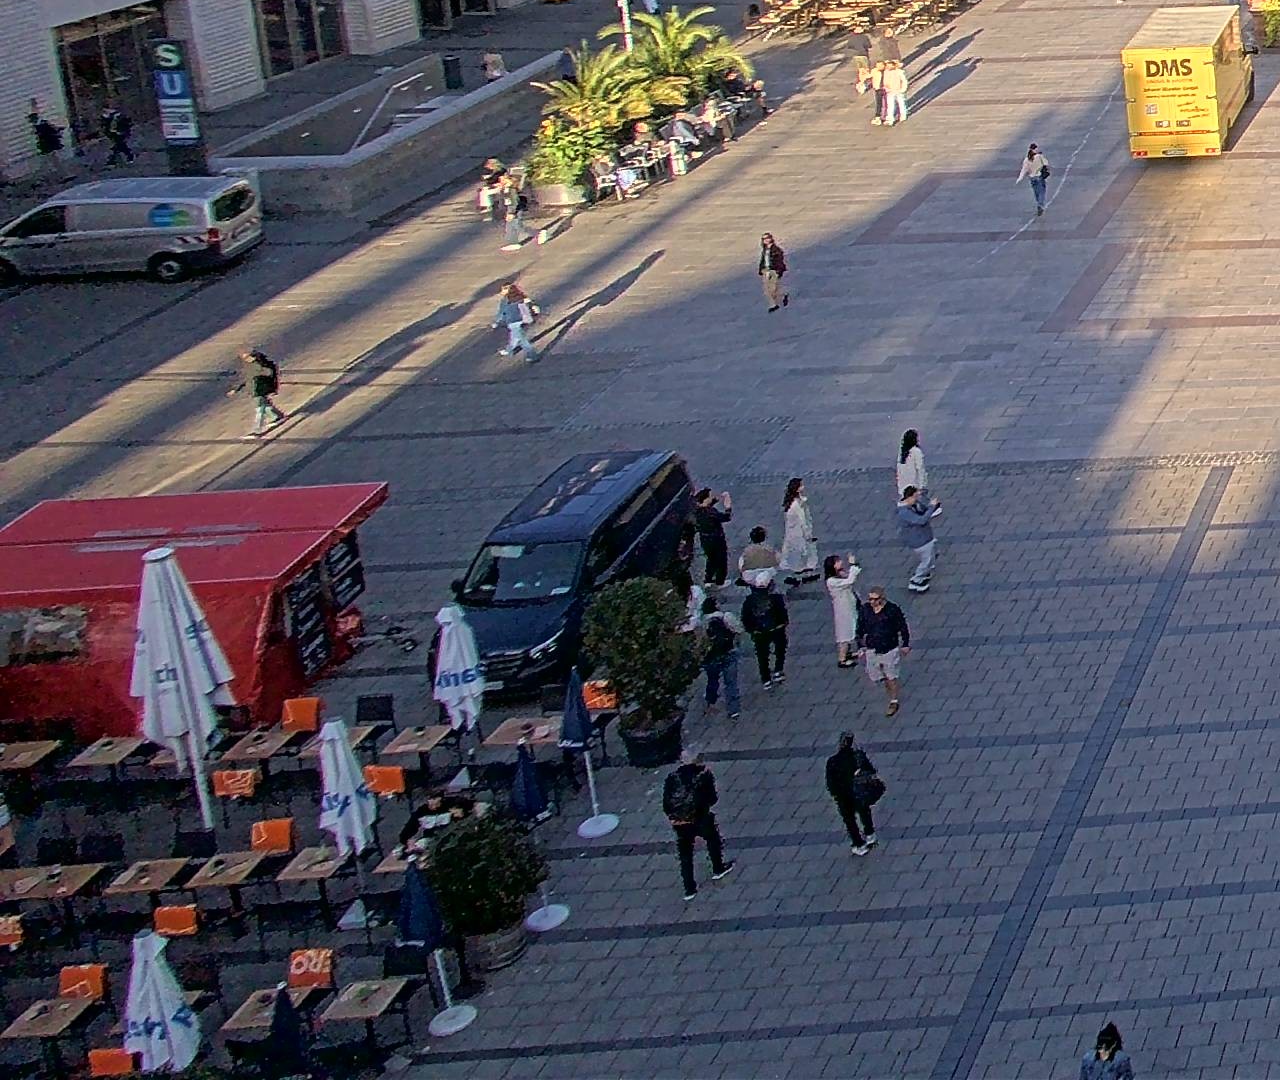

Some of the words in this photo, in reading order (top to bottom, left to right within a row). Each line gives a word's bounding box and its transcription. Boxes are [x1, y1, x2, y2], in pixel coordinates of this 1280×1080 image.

[153, 43, 180, 67] S
[1144, 58, 1193, 78] DMS
[160, 73, 182, 95] U
